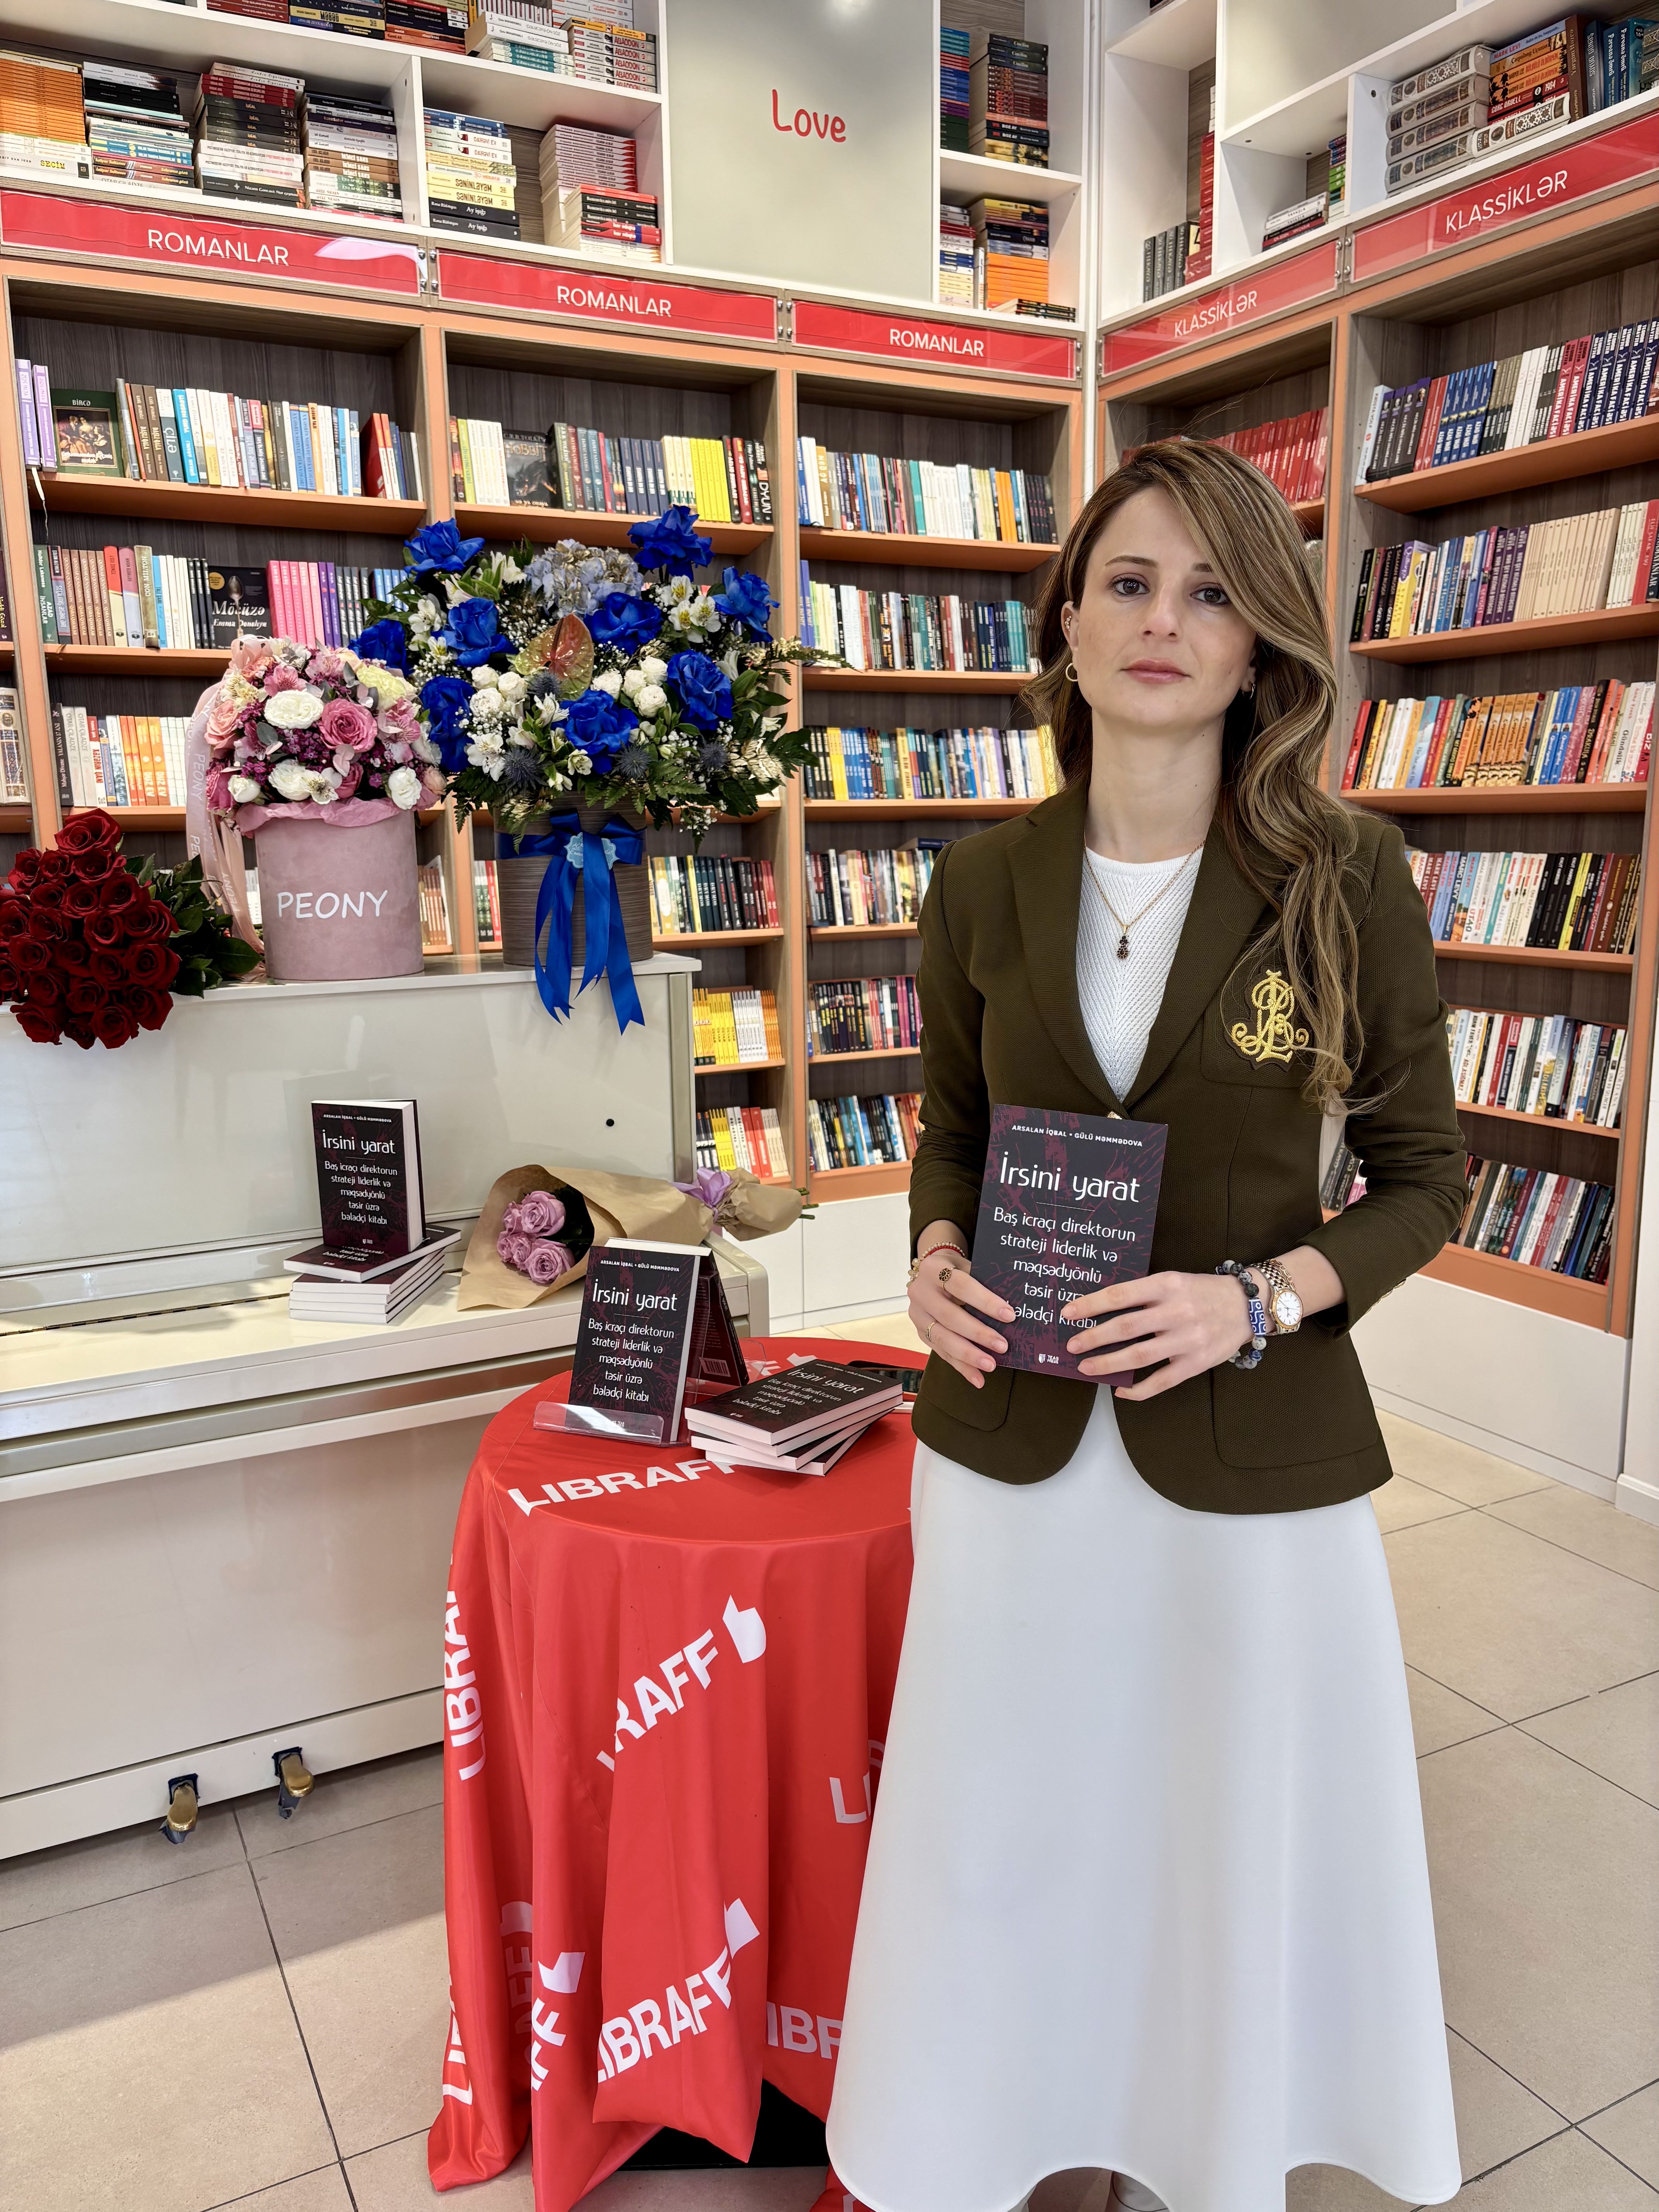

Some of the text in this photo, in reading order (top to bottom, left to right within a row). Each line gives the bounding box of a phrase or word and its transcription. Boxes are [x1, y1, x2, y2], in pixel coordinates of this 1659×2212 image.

[614, 36, 639, 48] ABADDON
[614, 48, 639, 60] ABADDON
[615, 59, 640, 71] ABADDON
[615, 70, 640, 82] ABADDON
[1544, 80, 1556, 93] 1984
[772, 89, 846, 142] Love
[455, 177, 492, 192] SƏNİNLƏYƏM
[456, 191, 493, 206] SƏNİNLƏYƏM
[466, 206, 474, 215] Ay
[1446, 170, 1567, 234] KLASSİKLƏR
[468, 222, 476, 231] Ay
[148, 229, 289, 266] ROMANLAR
[558, 286, 671, 315] ROMANLAR
[1175, 290, 1257, 338] KLASSİKLƏR
[890, 329, 983, 356] ROMANLAR
[1591, 368, 1609, 428] AMERİKA FACİƏSİ
[1605, 364, 1623, 425] AMERİKA FACİƏSİ
[1619, 361, 1638, 421] AMERİKA FACİƏSİ
[1634, 357, 1652, 419] AMERİKA FACİƏSİ
[72, 398, 91, 407] BİRCƏ
[1549, 379, 1567, 438] AMERİKA FACİƏSİ
[1561, 376, 1580, 435] AMERİKA FACİƏSİ
[1577, 373, 1594, 432] AMERİKA FACİƏSİ
[759, 483, 772, 514] DYUN
[40, 596, 48, 624] İNSANLAR
[212, 601, 265, 616] Möcüzə
[213, 619, 236, 628] Emma
[67, 726, 76, 752] ÇİLADZE
[79, 726, 88, 752] ÇİLADZE
[1614, 730, 1630, 765] Gündəlik
[143, 771, 155, 797] DUZ EV
[156, 771, 167, 797] DUZ EV
[191, 753, 206, 801] PEONY
[277, 890, 388, 921] PEONY
[1465, 908, 1476, 932] UTAQ
[322, 1129, 395, 1154] İrsini yarat
[1012, 1125, 1142, 1147] ARSALAN İQBAL GÜLÜ MƏMMƏDOVA
[325, 1161, 397, 1176] Baş icraçı direktorun
[331, 1175, 356, 1184] strateji
[358, 1176, 381, 1187] liderlik
[1000, 1151, 1140, 1203] İrsini yarat
[341, 1189, 385, 1200] məqsədyönlü
[349, 1201, 380, 1211] təsir üzrə
[342, 1212, 387, 1224] bələdçi kitabı
[994, 1207, 1136, 1242] Baş icraçı direktorun
[1000, 1233, 1118, 1262] strateji liderlik və
[1013, 1259, 1101, 1284] məqsədyönlü
[592, 1279, 678, 1311] İrsini yarat
[1024, 1282, 1053, 1298] təsir
[1007, 1300, 1054, 1325] ələdçi
[589, 1318, 674, 1339] Baş icraçı direktorun
[592, 1338, 663, 1354] strateji liderlik və
[599, 1355, 653, 1369] məqsədyönlü
[605, 1370, 643, 1384] təsir üzrə
[787, 1368, 827, 1382] İrsini
[825, 1378, 866, 1394] yarat
[593, 1384, 649, 1402] bələdçi kitabı
[803, 1386, 842, 1402] direktorun
